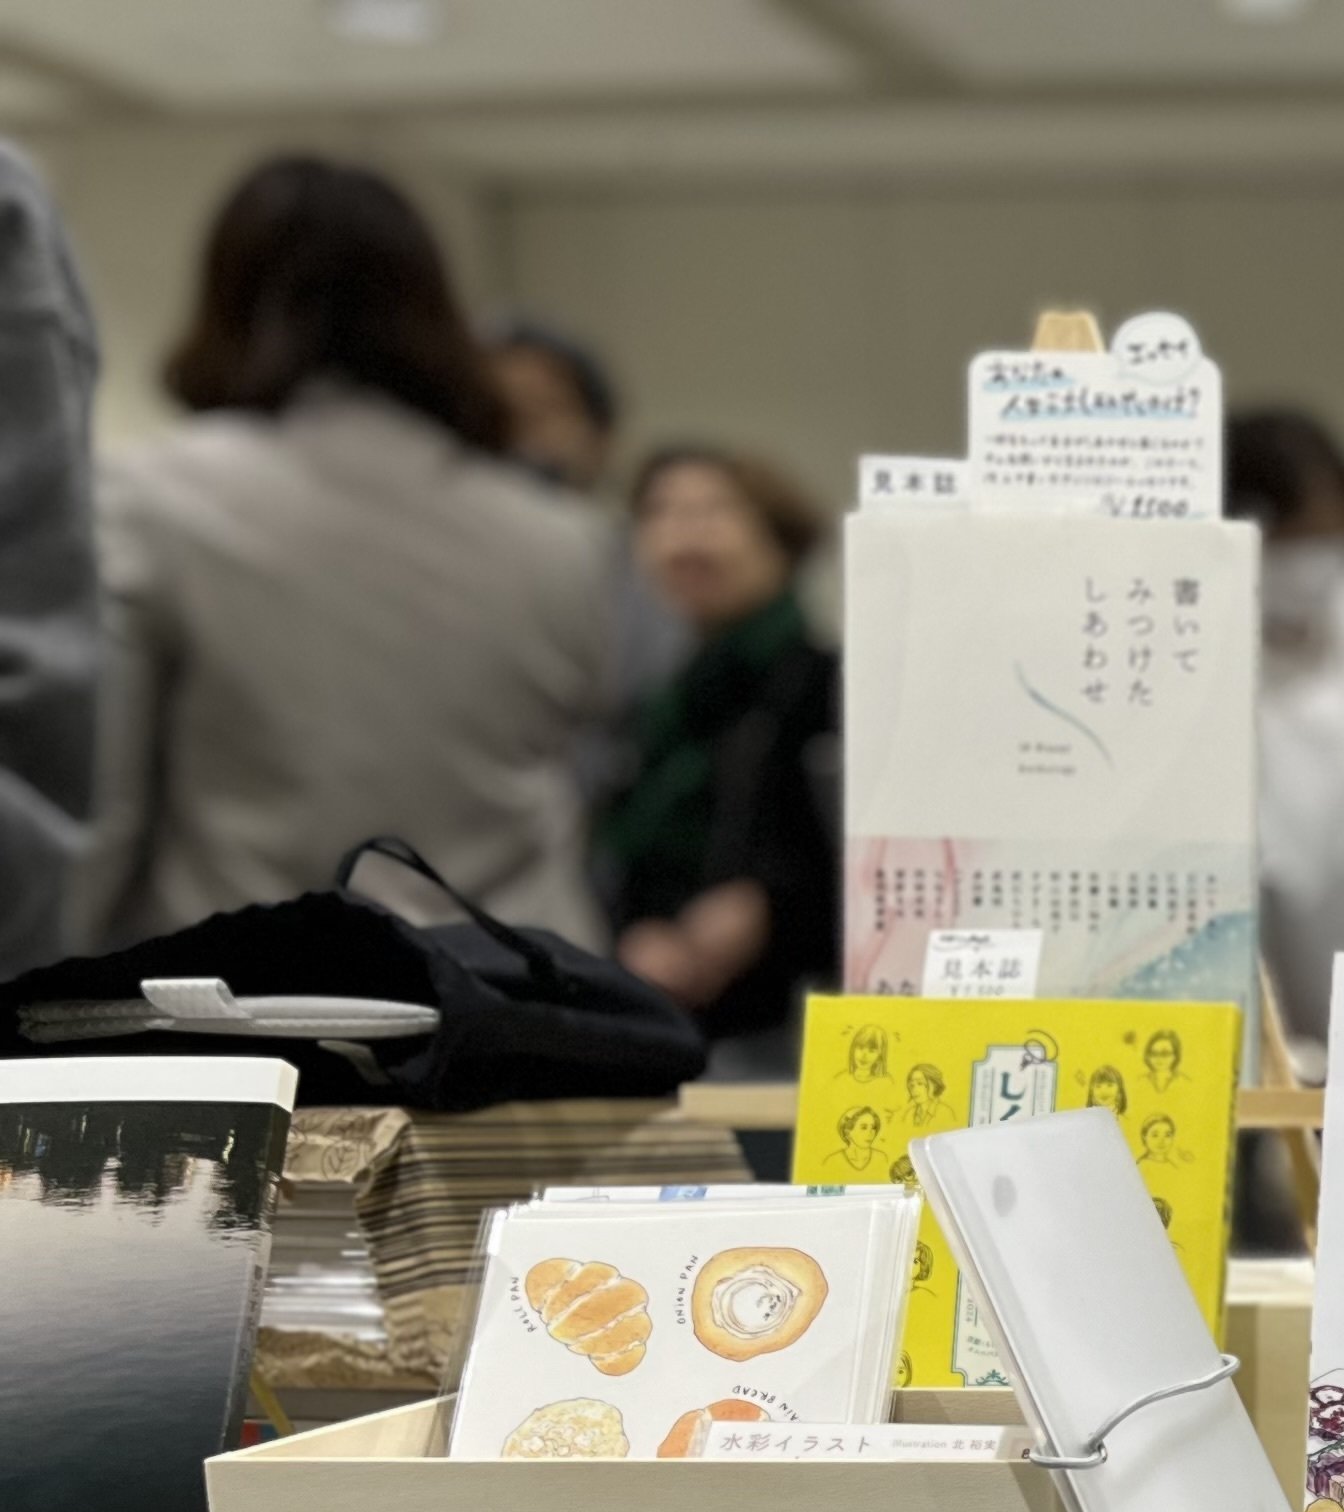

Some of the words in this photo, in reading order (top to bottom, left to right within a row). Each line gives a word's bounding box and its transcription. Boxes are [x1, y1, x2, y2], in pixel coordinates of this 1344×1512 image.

[872, 471, 958, 495] 見本誌
[1173, 578, 1201, 673] 書いて
[1082, 578, 1108, 705] しあわせ
[1127, 578, 1154, 706] みつけた
[942, 958, 1021, 980] 見本誌
[680, 1255, 699, 1280] PAN
[510, 1276, 519, 1301] PAN
[720, 1433, 870, 1453] 水彩イラスト
